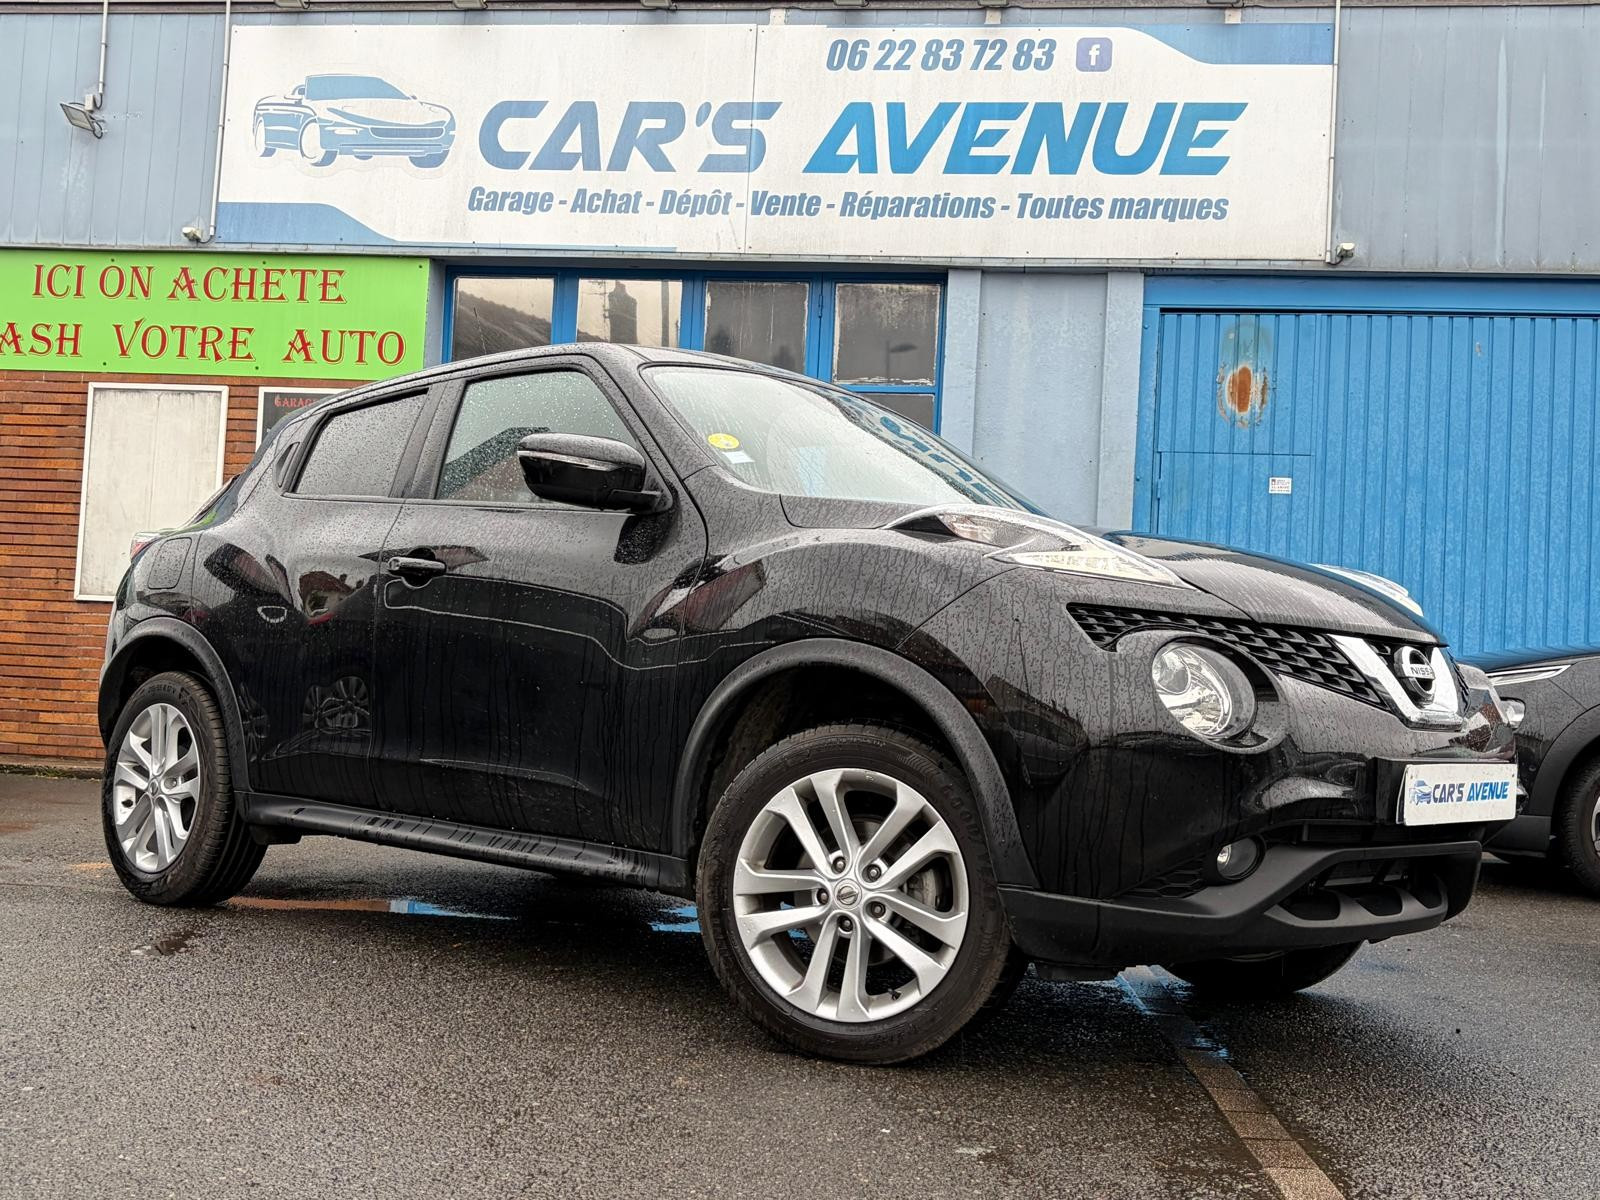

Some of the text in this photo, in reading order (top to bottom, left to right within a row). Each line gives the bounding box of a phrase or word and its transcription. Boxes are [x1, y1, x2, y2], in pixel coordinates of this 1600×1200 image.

[826, 39, 1057, 71] 06 22 83 72 83
[478, 100, 1249, 176] CAR'S AVENUE
[467, 186, 554, 216] Garage
[570, 188, 642, 214] Achat
[658, 188, 733, 218] Dépôt
[750, 190, 822, 217] Vente
[839, 191, 995, 221] Réparations
[1016, 192, 1103, 220] Toutes
[1107, 194, 1229, 224] marques
[32, 264, 347, 304] ICI ON ACHETE
[112, 317, 256, 364] VOTRE
[282, 328, 407, 366] AUTO
[274, 396, 317, 408] GARAG
[1410, 666, 1434, 676] NISS
[1432, 781, 1510, 804] CAR'S AVENUE
